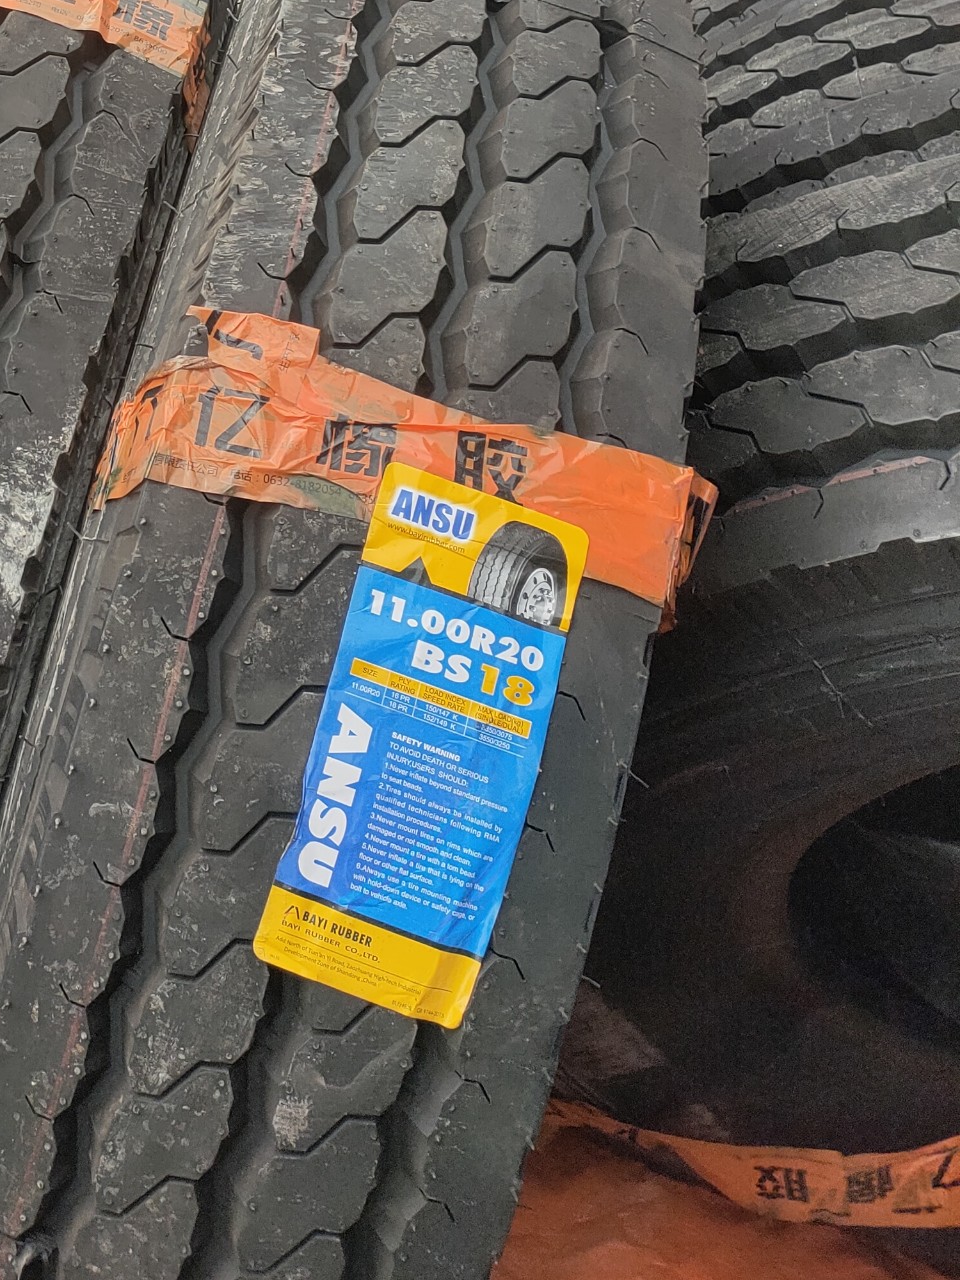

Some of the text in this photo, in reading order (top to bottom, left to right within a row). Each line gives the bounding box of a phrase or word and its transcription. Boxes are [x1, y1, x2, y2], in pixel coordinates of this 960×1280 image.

[392, 489, 475, 540] ANSU
[370, 588, 544, 671] 11.00R20
[362, 666, 378, 677] SIZE
[397, 676, 410, 685] PLY
[350, 681, 381, 698] 11.00R20
[389, 681, 415, 695] RATING
[390, 691, 410, 704] 16 PR
[424, 685, 466, 706] LOAD INDEX
[388, 700, 408, 713] 18 PR
[422, 692, 464, 713] SPEED RATE
[424, 703, 458, 721] 150/147 K
[422, 712, 456, 731] 152/149 K
[391, 731, 461, 762] SAFETY WARNING
[388, 741, 489, 783] TO AVOID DEATH OR SERIOUS
[437, 770, 469, 787] SHOULD:
[298, 704, 373, 888] ANSU
[281, 919, 300, 932] BAYI
[304, 929, 340, 947] RUBBER
[301, 911, 372, 947] BAYI RUBBER
